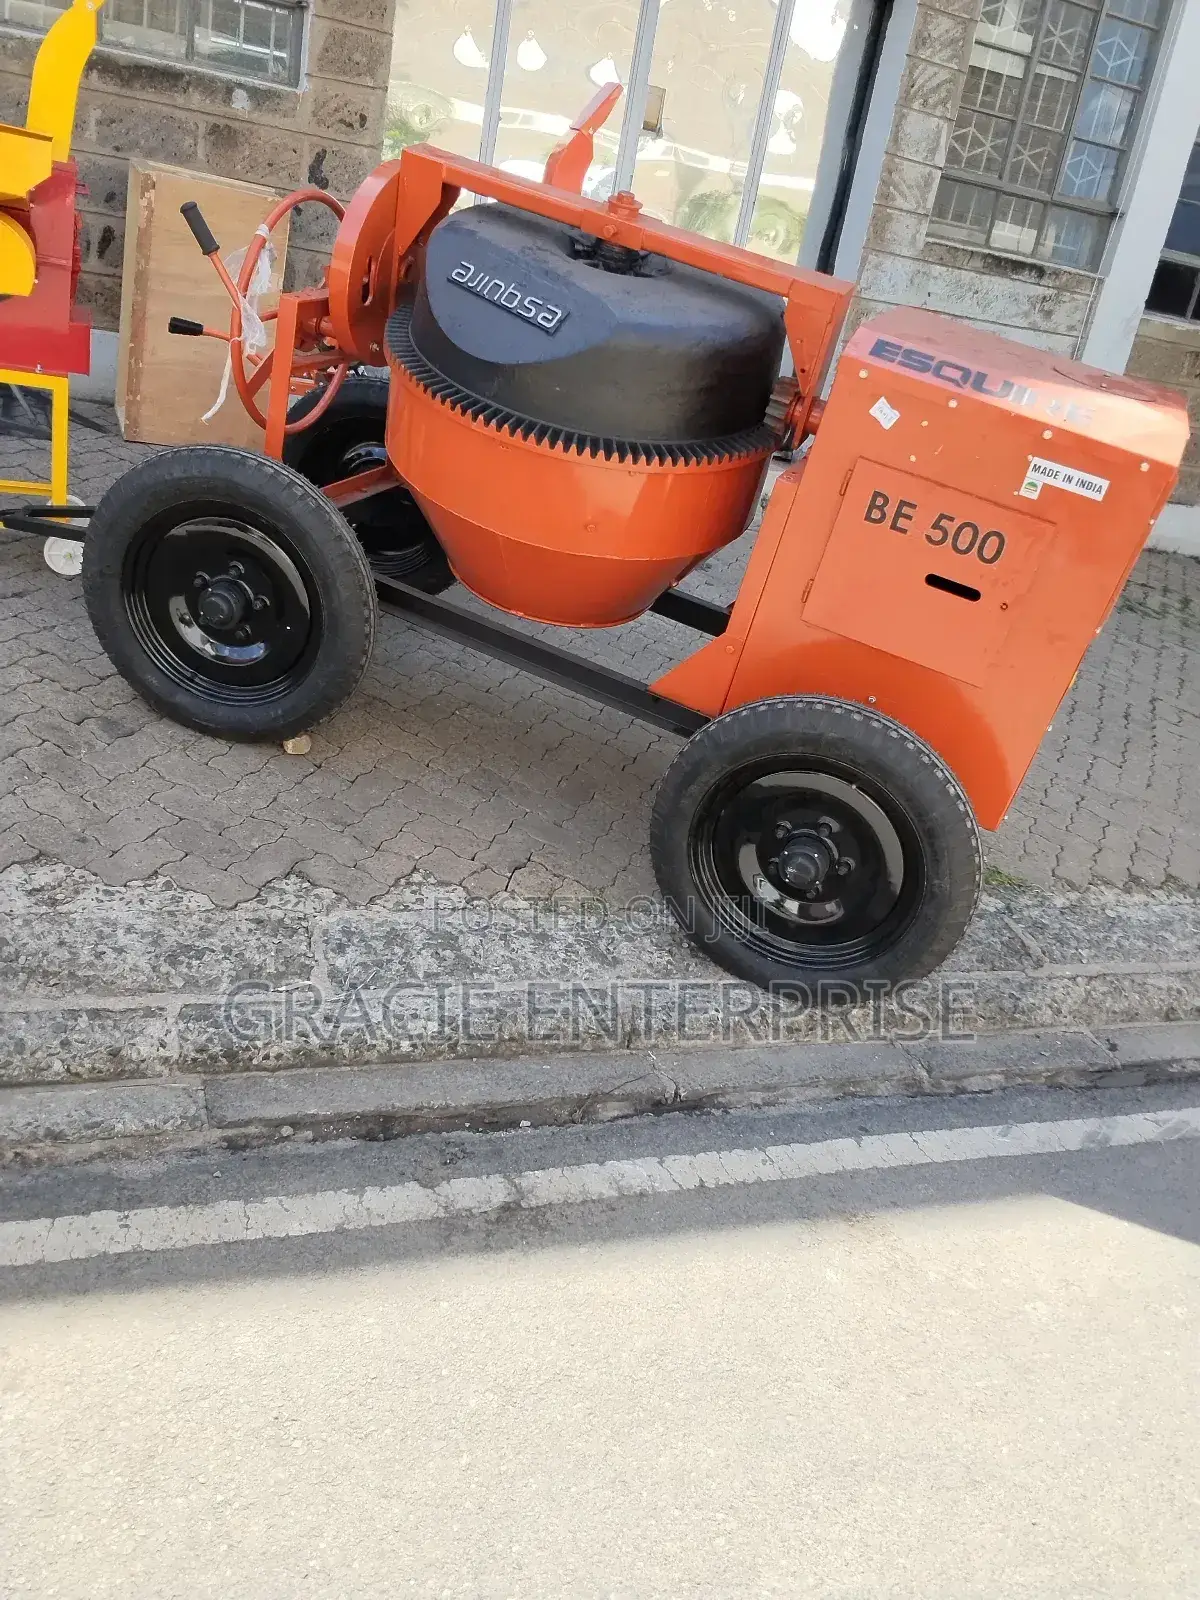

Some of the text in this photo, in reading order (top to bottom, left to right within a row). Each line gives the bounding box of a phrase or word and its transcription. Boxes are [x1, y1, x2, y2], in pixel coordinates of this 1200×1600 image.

[451, 261, 562, 328] esquire
[1031, 464, 1103, 495] MADE IN INDIA
[864, 490, 1005, 565] BE 500
